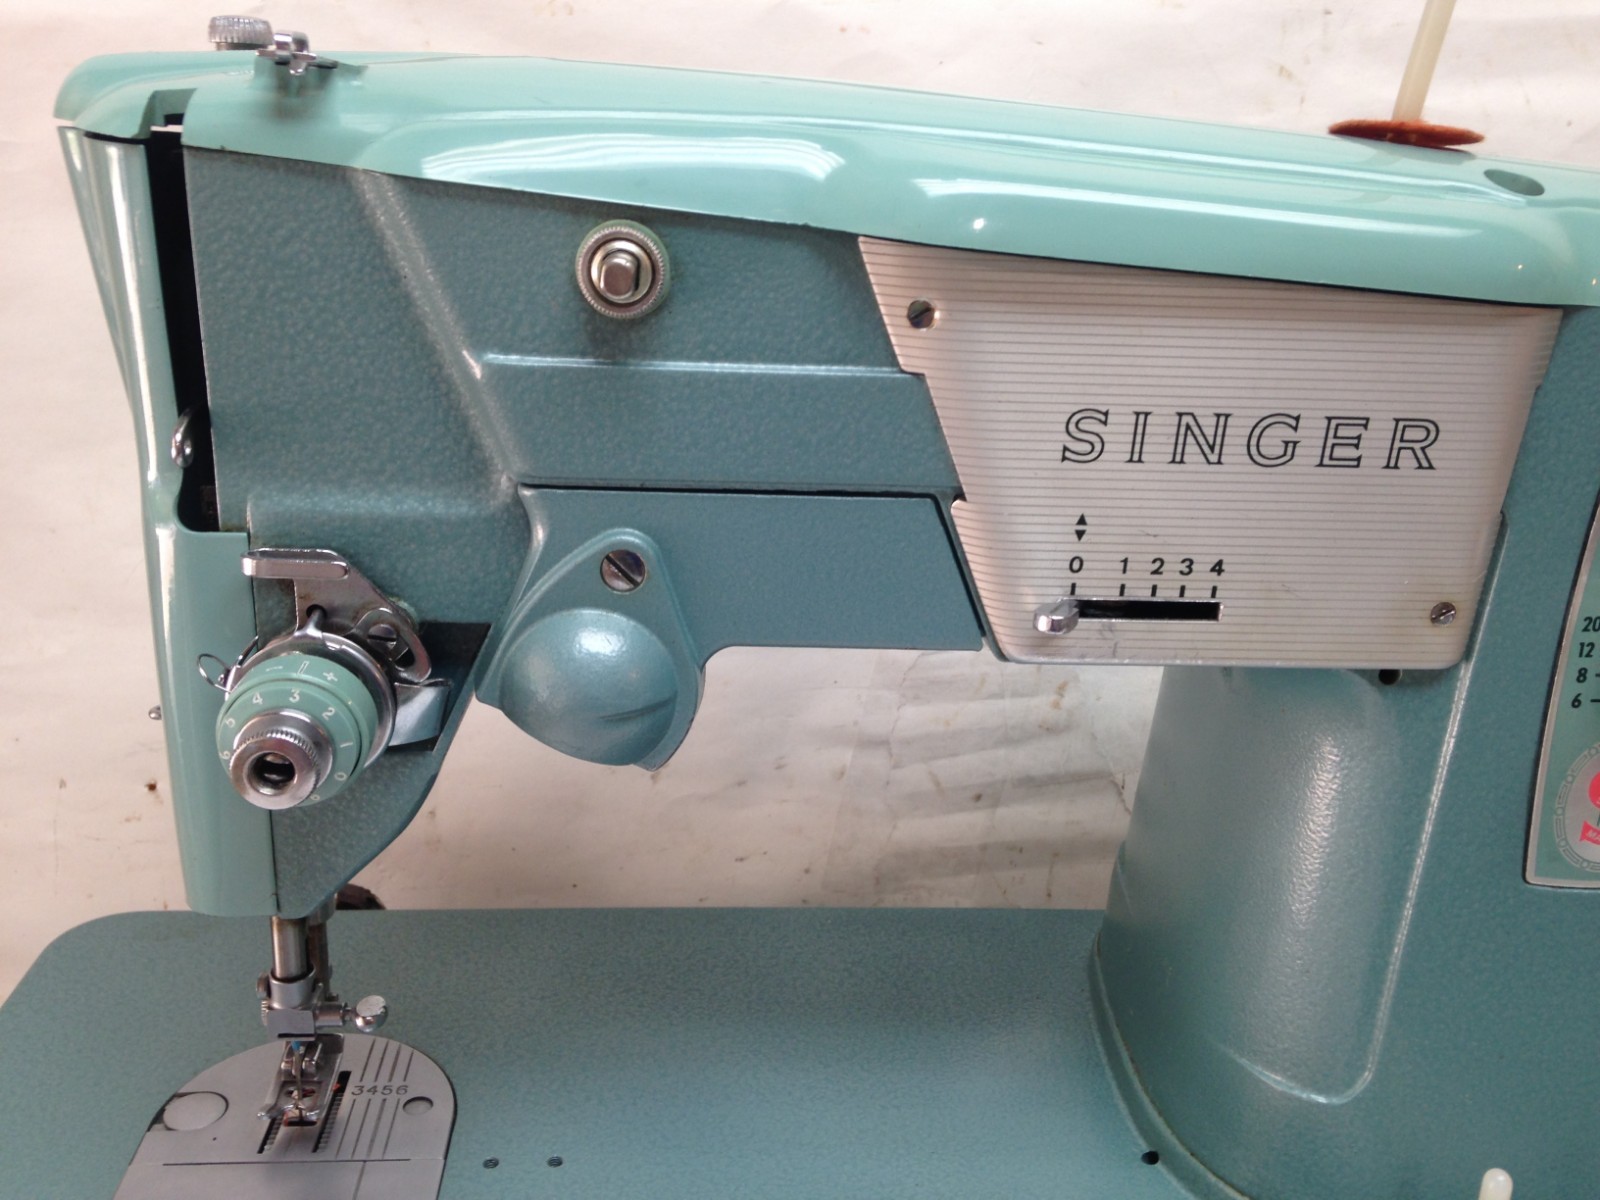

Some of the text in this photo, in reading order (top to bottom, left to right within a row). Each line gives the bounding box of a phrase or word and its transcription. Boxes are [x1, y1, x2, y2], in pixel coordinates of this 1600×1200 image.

[1061, 408, 1440, 470] SINGER
[1068, 556, 1225, 576] 0 1 2 3 4
[1578, 642, 1595, 658] 12
[1576, 667, 1588, 683] 8
[252, 692, 264, 705] 4
[289, 689, 300, 703] 3
[321, 706, 335, 721] 2
[1571, 693, 1582, 708] 6
